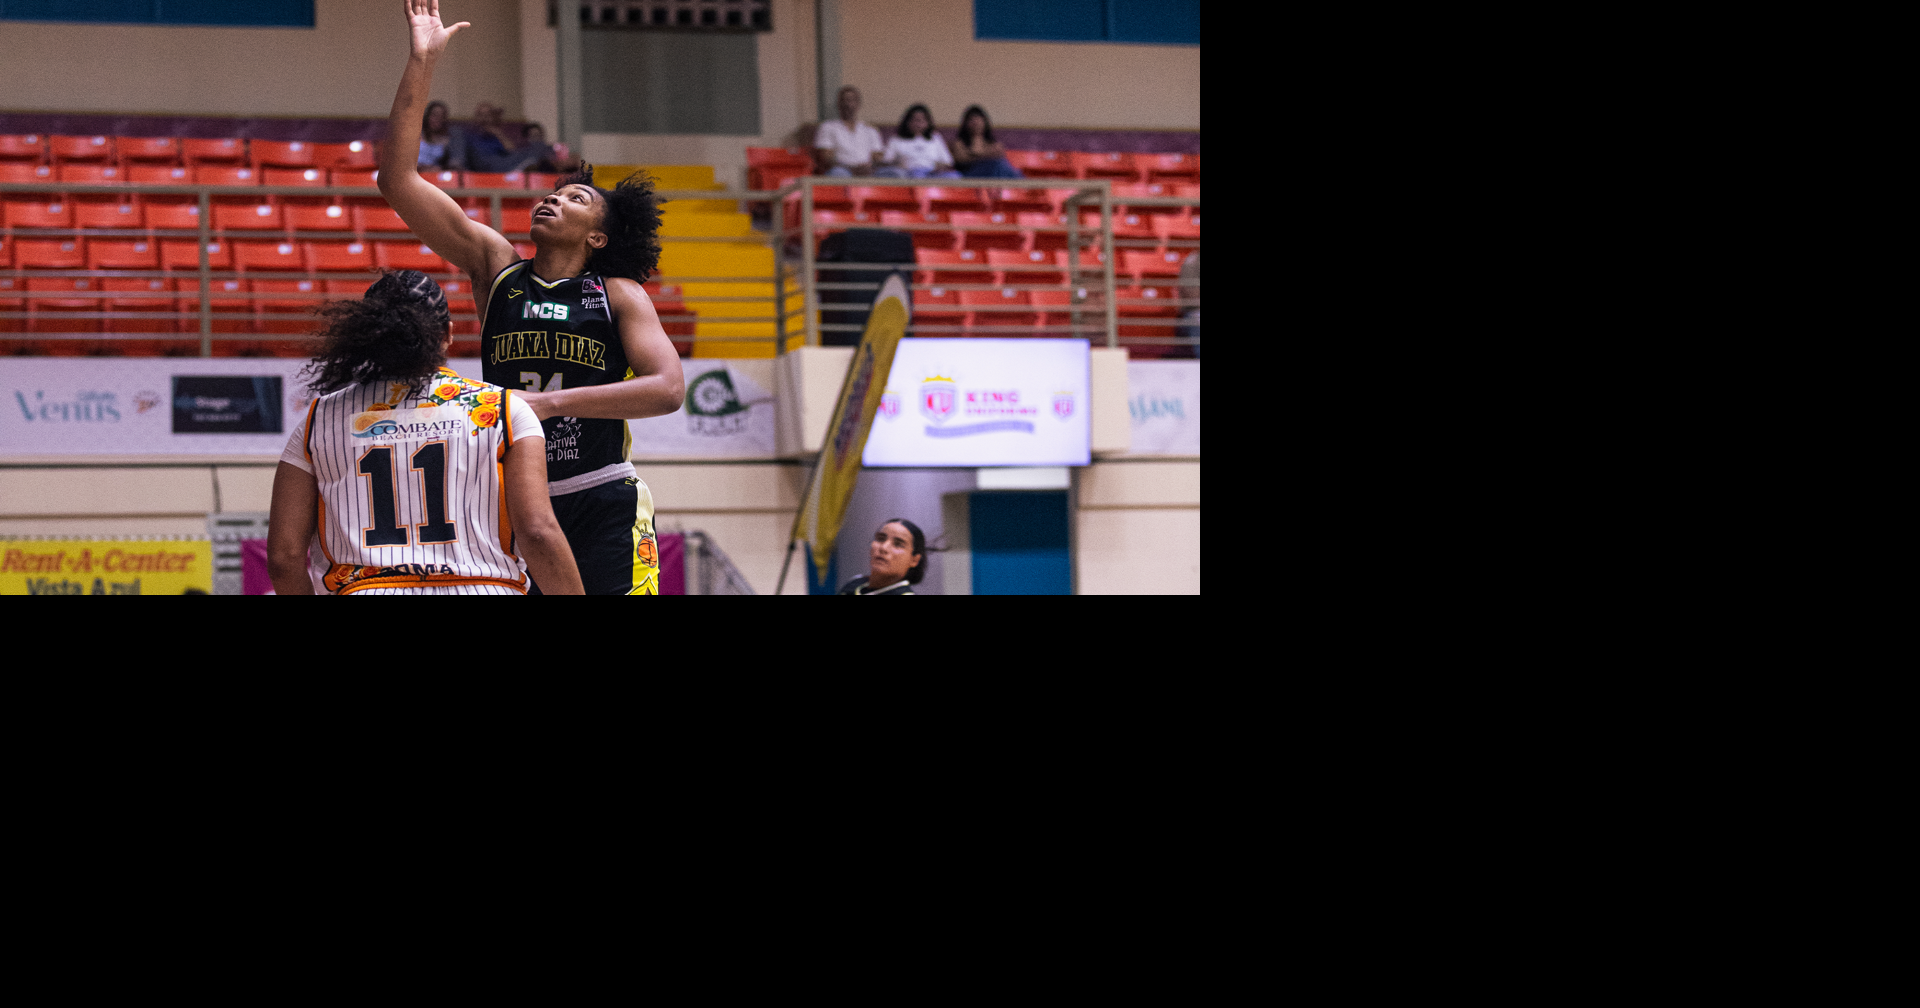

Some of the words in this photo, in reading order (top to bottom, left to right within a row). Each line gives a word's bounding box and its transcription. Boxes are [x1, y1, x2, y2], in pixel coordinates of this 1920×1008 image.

[581, 296, 605, 304] plane
[491, 331, 550, 366] JUANA
[555, 331, 606, 371] DIAZ
[14, 390, 121, 422] Venus
[371, 420, 462, 435] COMBATE
[417, 429, 460, 438] RESORT
[356, 440, 458, 548] 11
